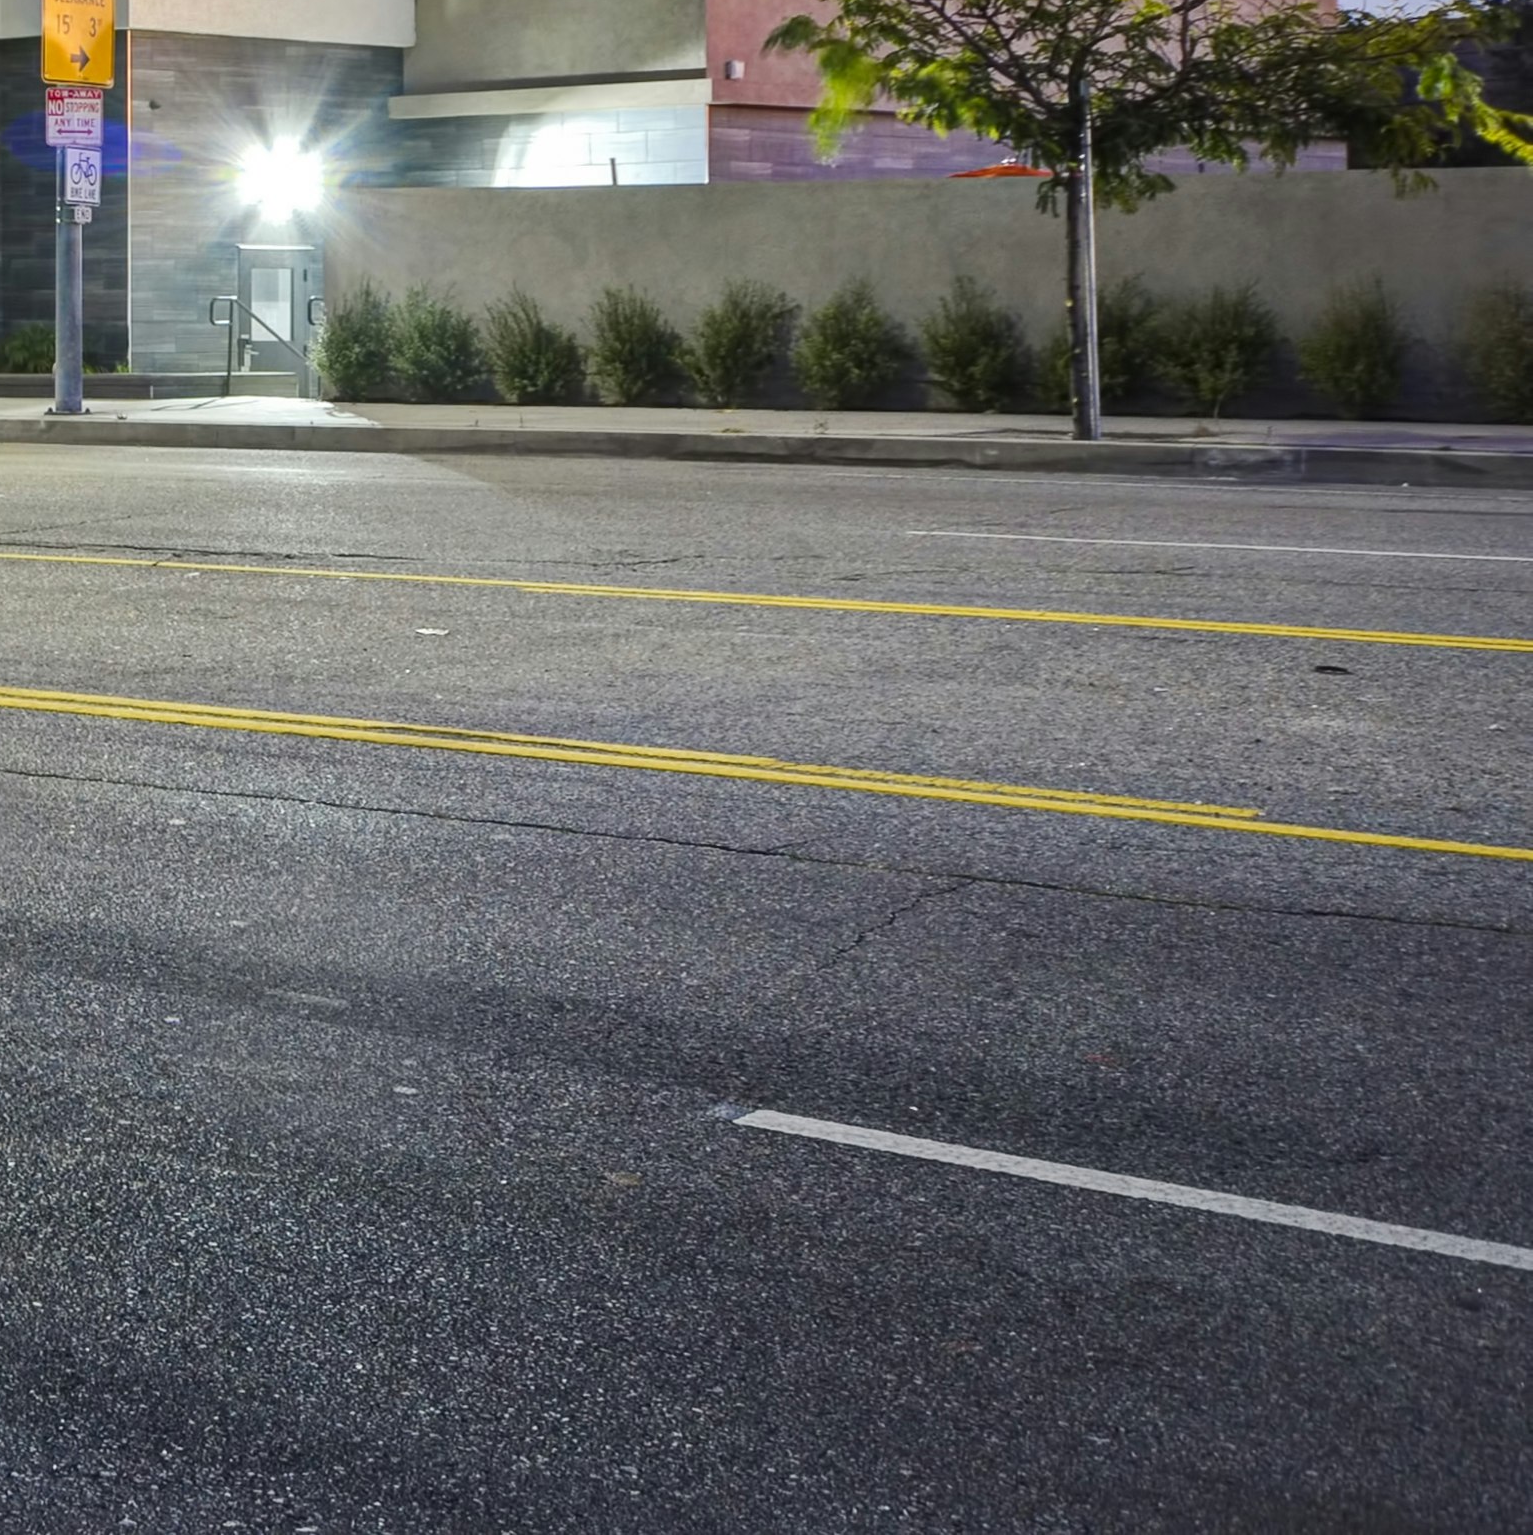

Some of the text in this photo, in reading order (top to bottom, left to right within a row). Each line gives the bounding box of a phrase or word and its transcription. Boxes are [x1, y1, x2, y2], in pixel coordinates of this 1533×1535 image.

[48, 89, 100, 98] TOW-AWAY
[48, 99, 99, 115] NO STOPPING
[54, 117, 96, 127] ANY TIME
